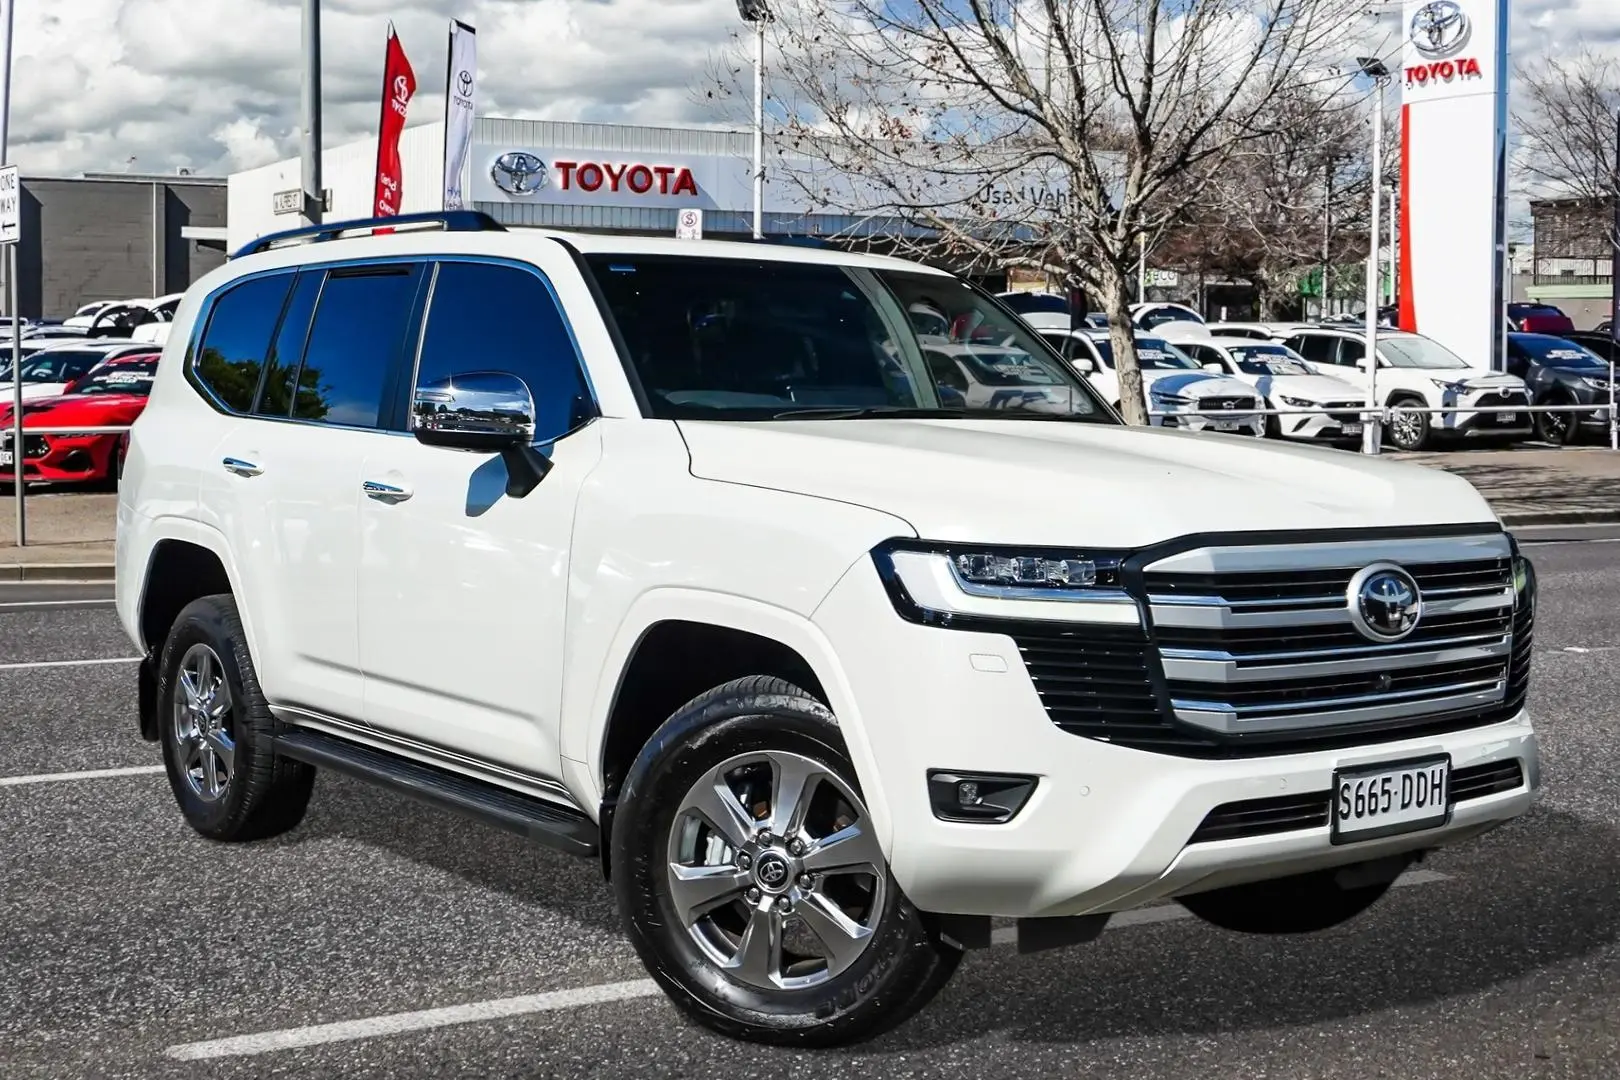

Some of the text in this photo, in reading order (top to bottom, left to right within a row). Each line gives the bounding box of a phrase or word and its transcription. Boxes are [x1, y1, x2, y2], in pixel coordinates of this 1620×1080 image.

[1404, 58, 1480, 83] TOYOTA
[555, 161, 698, 196] TOYOTA
[977, 186, 1025, 204] Used
